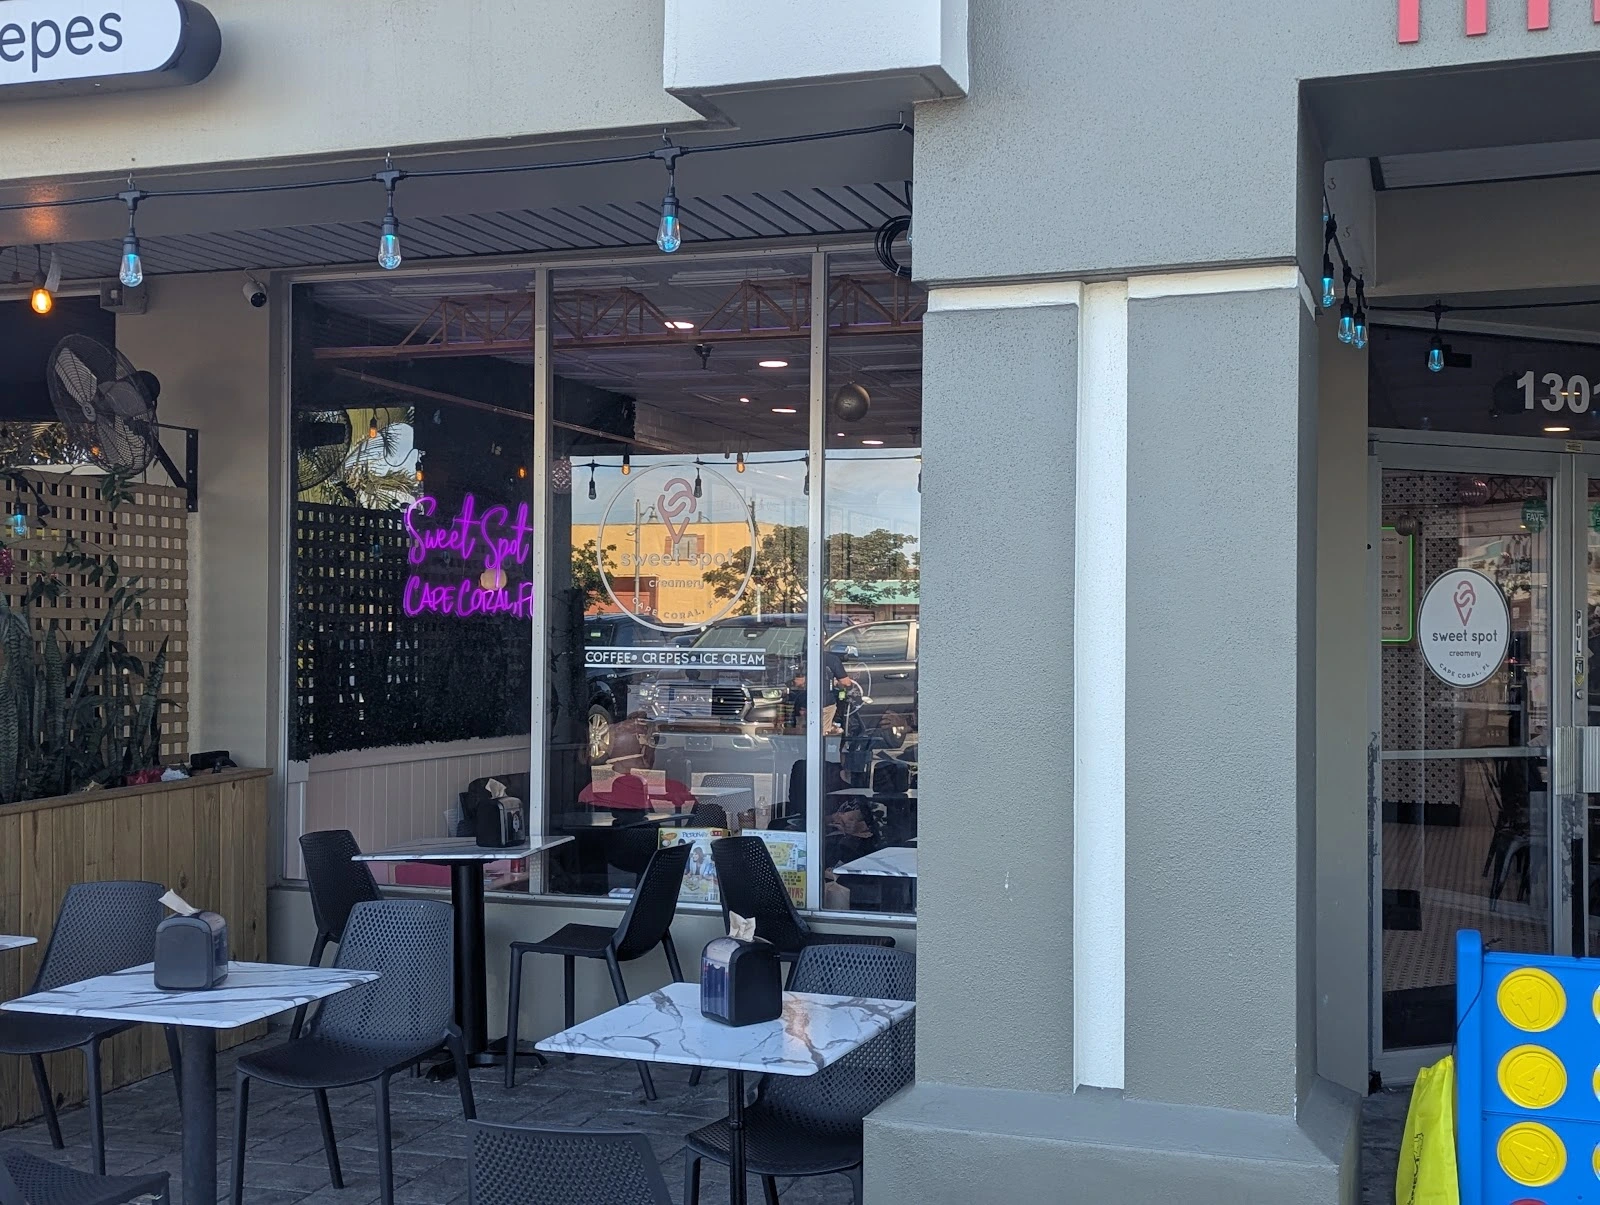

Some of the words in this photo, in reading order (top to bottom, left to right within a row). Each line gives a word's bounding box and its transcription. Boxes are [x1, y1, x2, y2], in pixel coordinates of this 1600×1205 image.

[404, 492, 480, 564] Sweet
[481, 502, 533, 588] Spot
[621, 549, 681, 566] sweet
[688, 548, 734, 570] spot
[648, 579, 705, 590] creamery
[403, 575, 456, 615] CAPE
[632, 597, 658, 617] CAPE
[1432, 629, 1468, 642] sweet
[1471, 629, 1498, 645] spot
[585, 651, 632, 664] COFFEE
[642, 652, 689, 665] CREPES
[699, 653, 719, 665] ICE
[722, 653, 765, 666] CREAM
[1448, 650, 1482, 659] creamery
[1439, 662, 1456, 677] CAPE
[1482, 663, 1491, 671] FL
